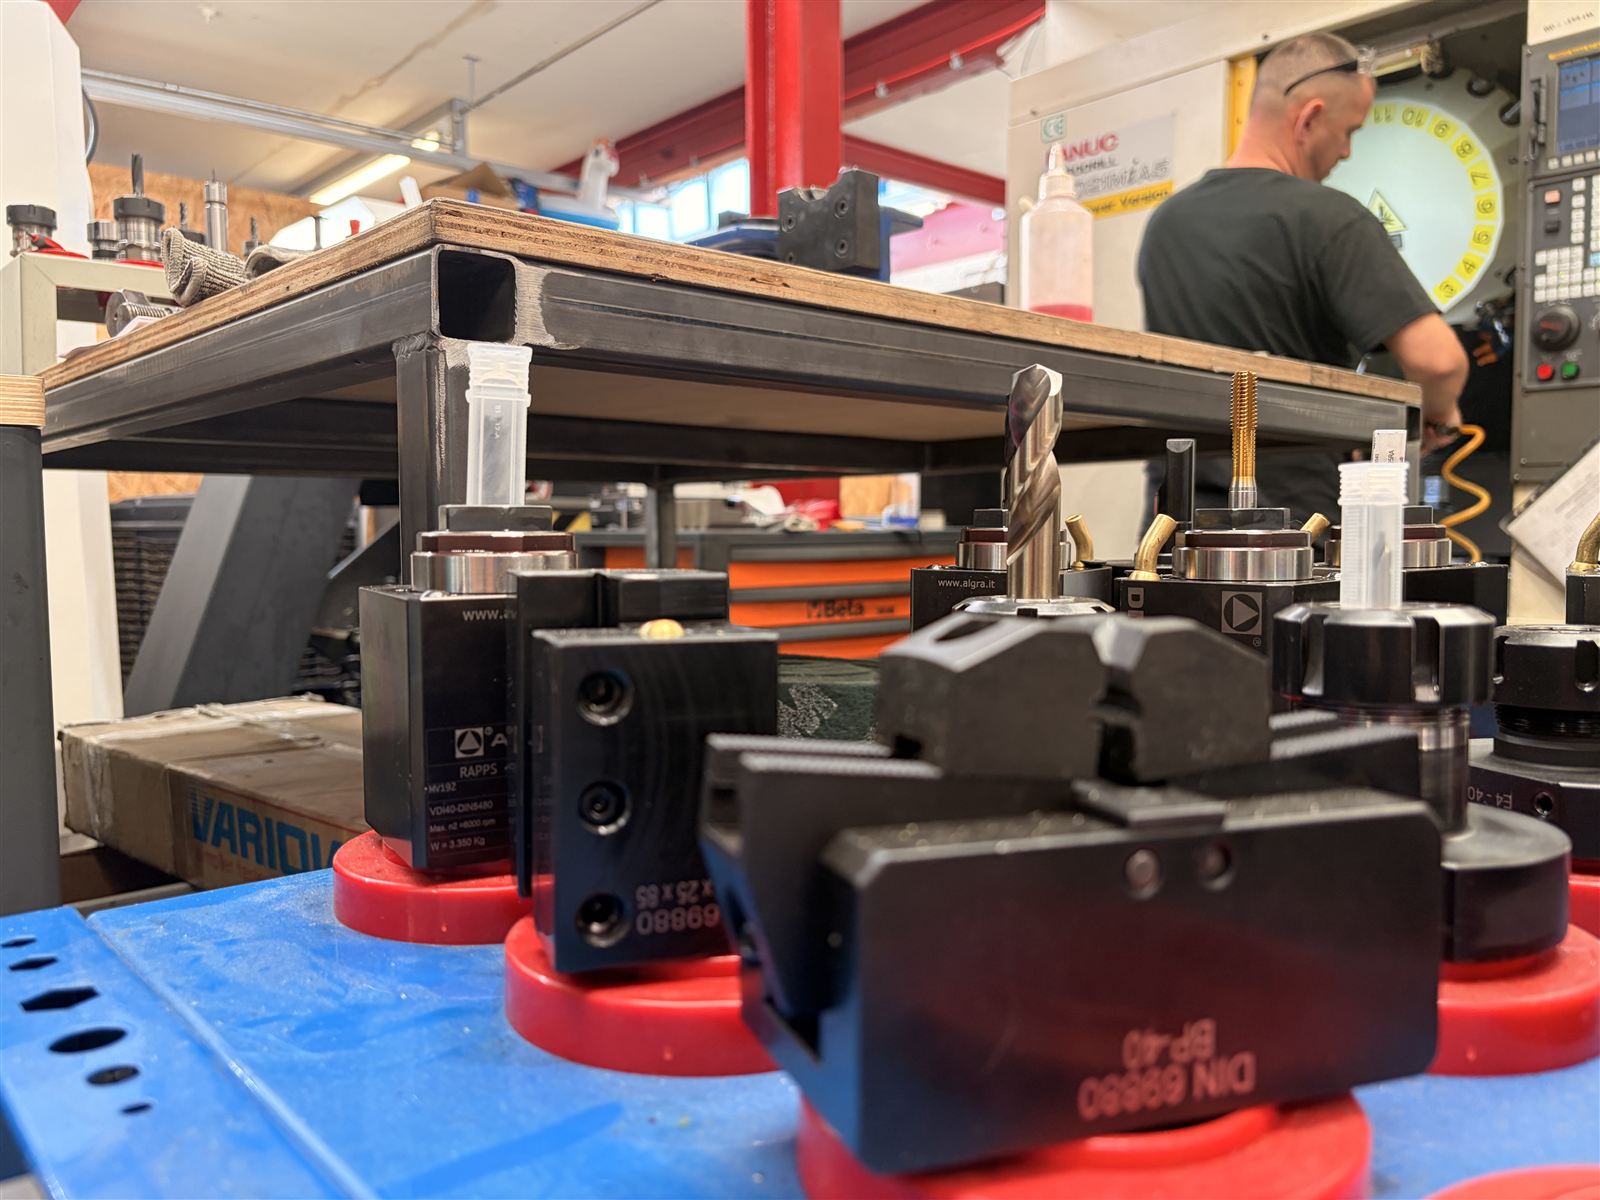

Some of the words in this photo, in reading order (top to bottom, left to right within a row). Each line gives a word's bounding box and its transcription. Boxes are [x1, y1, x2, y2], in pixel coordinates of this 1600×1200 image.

[1402, 108, 1424, 128] 10
[1470, 170, 1490, 184] 7
[1461, 257, 1477, 274] 4
[937, 578, 996, 590] www.algra.it
[460, 763, 498, 778] RAPPS
[430, 842, 440, 851] W
[676, 880, 700, 905] 25
[636, 904, 720, 936] 69880
[1192, 1052, 1256, 1098] DIN
